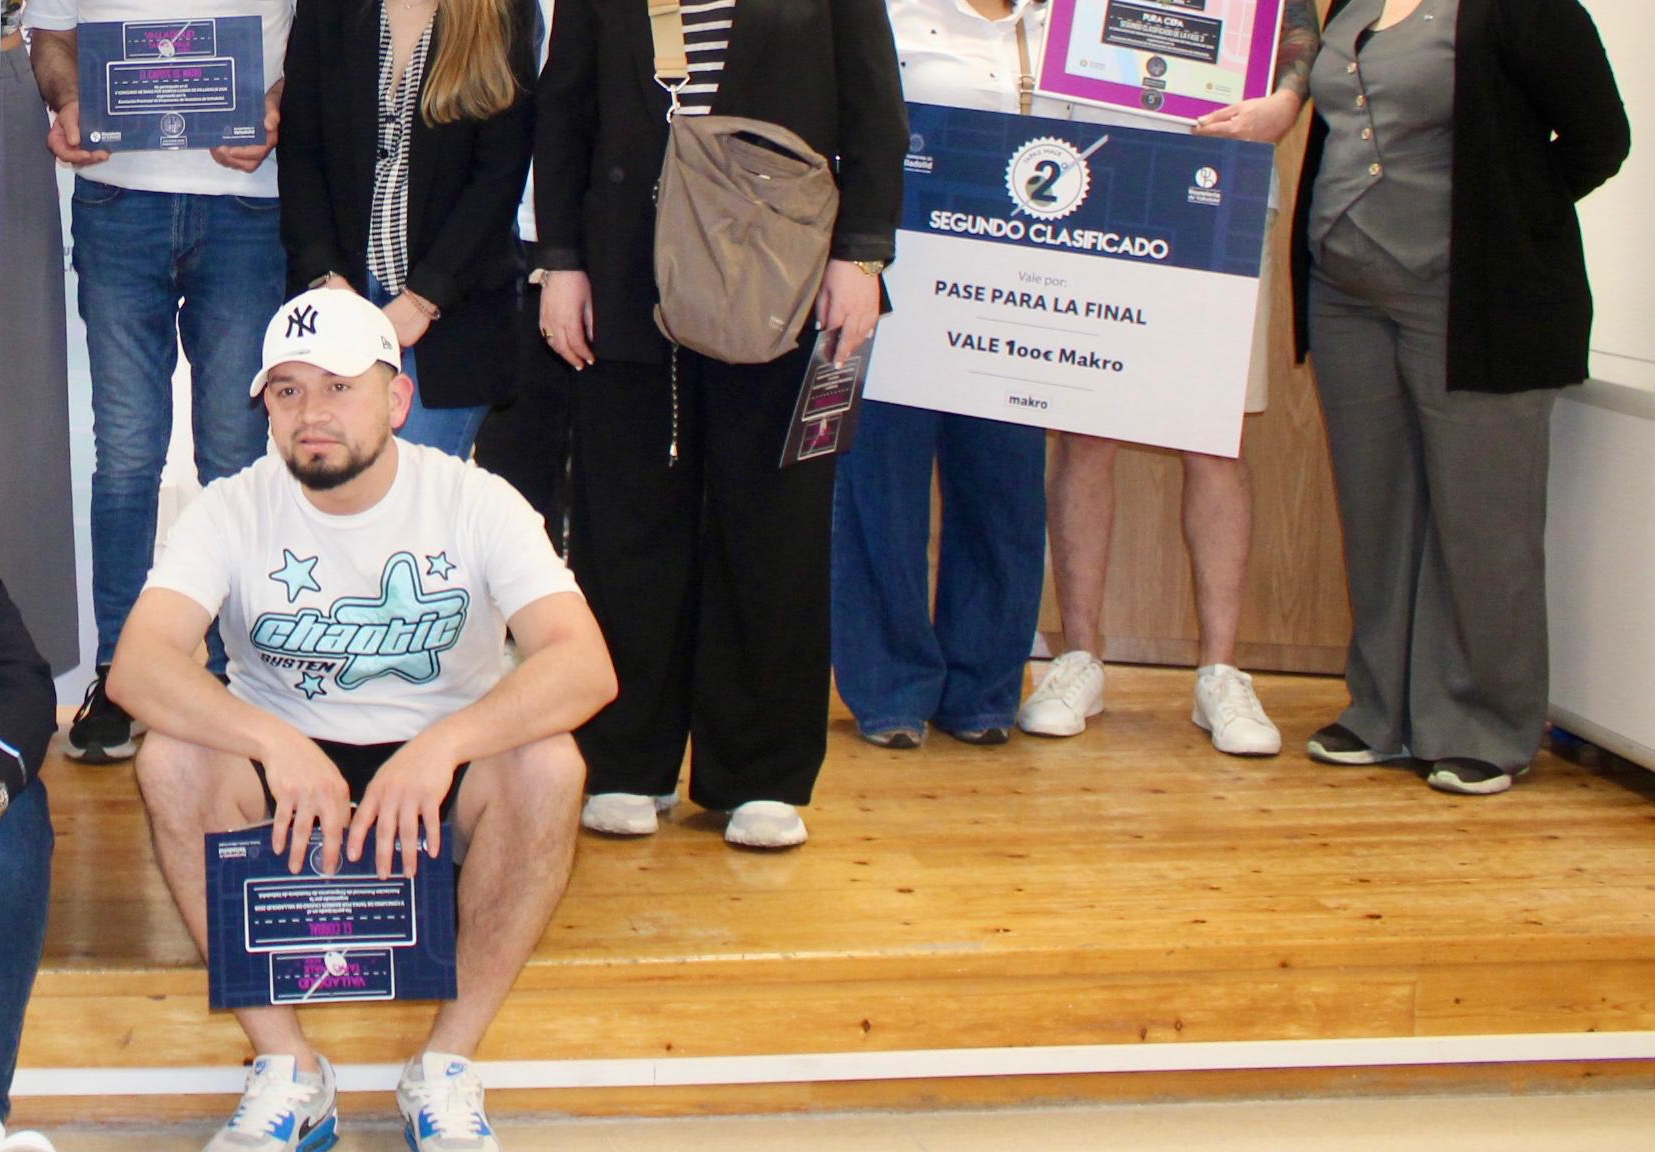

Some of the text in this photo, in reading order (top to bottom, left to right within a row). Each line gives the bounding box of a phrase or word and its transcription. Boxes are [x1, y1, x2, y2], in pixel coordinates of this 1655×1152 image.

[1142, 12, 1185, 28] PURA CEPA
[929, 210, 1169, 260] SEGUNDO CLASIFICADO
[1018, 270, 1068, 289] Vale por:
[934, 280, 1147, 326] PASE PARA LA FINAL
[285, 304, 319, 339] NY
[947, 331, 1000, 354] VALE
[1058, 348, 1124, 373] Makro
[1008, 394, 1048, 410] makro
[253, 612, 464, 656] chaotic
[260, 652, 336, 673] SYSTEM
